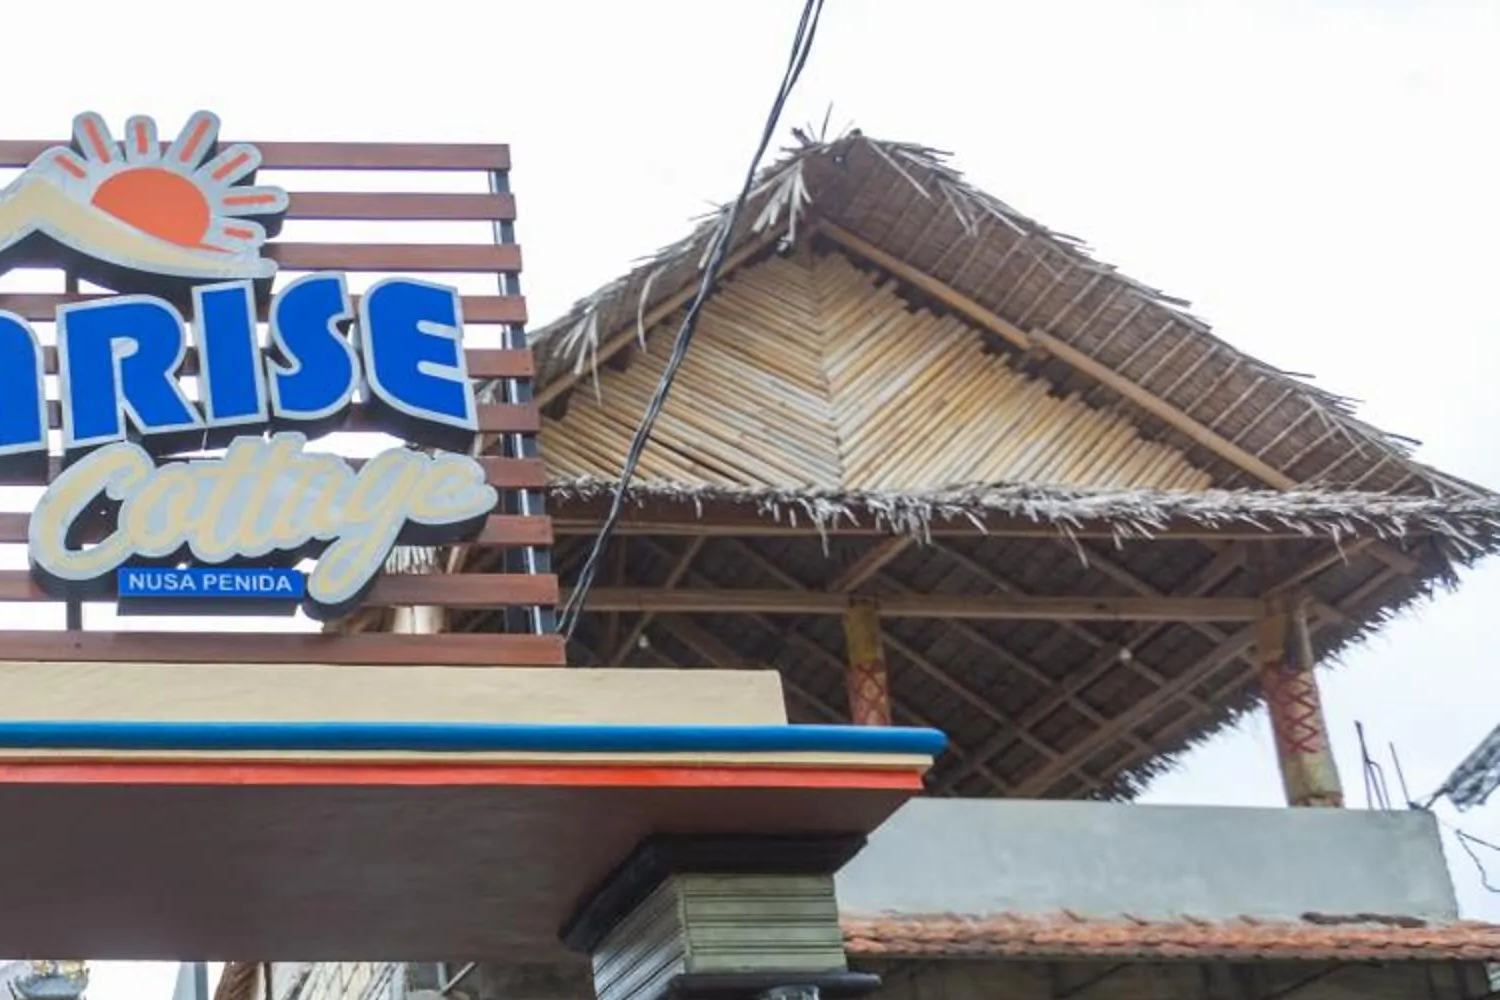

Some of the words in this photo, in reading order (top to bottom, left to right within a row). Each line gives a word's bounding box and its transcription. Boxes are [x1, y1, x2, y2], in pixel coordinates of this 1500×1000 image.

[31, 432, 496, 603] Cottage
[128, 573, 197, 591] NUSA
[202, 574, 294, 592] PENIDA
